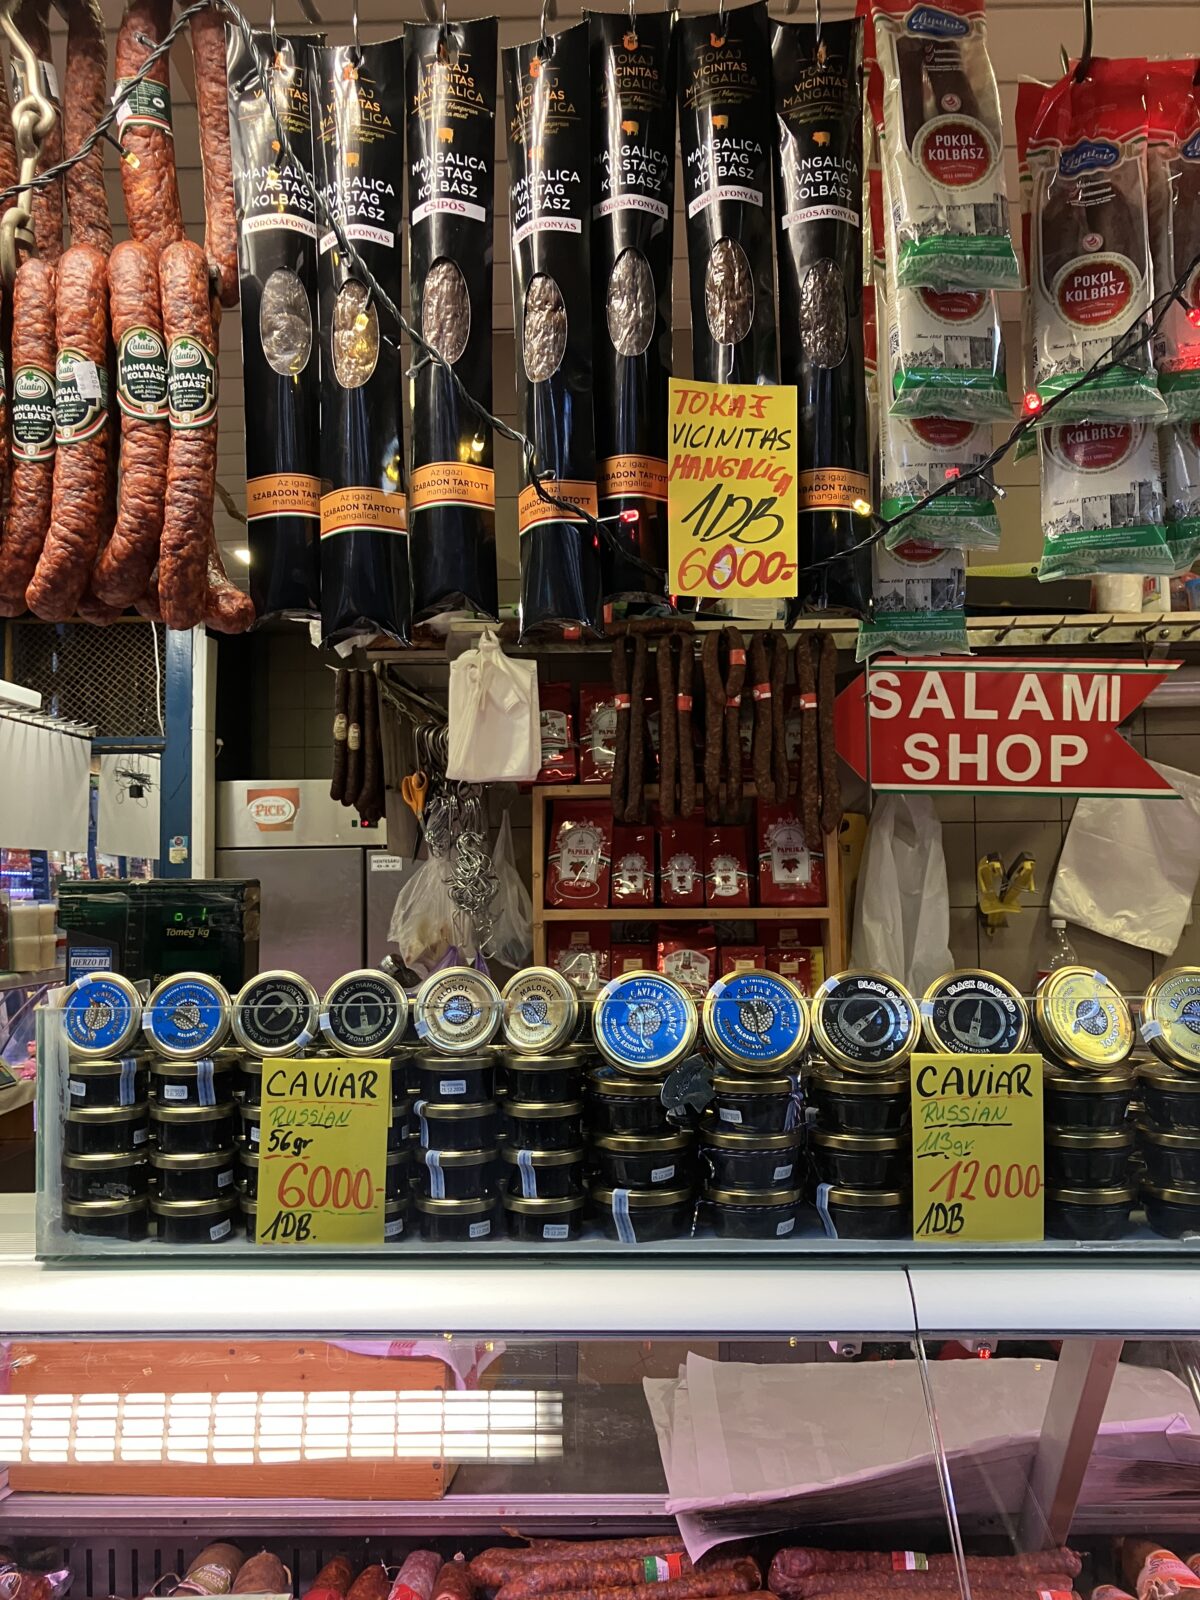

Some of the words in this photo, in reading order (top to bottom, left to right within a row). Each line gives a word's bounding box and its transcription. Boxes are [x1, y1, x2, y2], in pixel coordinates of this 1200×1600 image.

[693, 61, 748, 79] VICINITAS
[794, 76, 849, 92] VICINITAS
[936, 134, 976, 147] POKOL
[687, 137, 763, 167] MANGALICA
[928, 145, 985, 161] KOLBÁSZ
[412, 152, 488, 177] MANGALICA
[605, 159, 657, 175] VASTAG
[697, 152, 749, 170] VASTAG
[421, 166, 473, 183] VASTAG
[601, 173, 661, 192] KOLBÁSZ
[795, 170, 849, 186] VASTAG
[255, 179, 310, 197] VASTAG
[319, 176, 395, 197] MANGALICA
[418, 178, 479, 201] KOLBÁSZ
[792, 184, 853, 201] KOLBÁSZ
[251, 193, 315, 214] KOLBÁSZ
[517, 185, 565, 206] VASTAG
[514, 198, 571, 225] KOLBÁSZ
[1074, 270, 1117, 288] POKOL
[1065, 280, 1125, 303] KOLBÁSZ
[672, 422, 793, 451] VICINITAS
[431, 469, 440, 477] Az
[442, 468, 463, 478] igazi
[616, 461, 627, 469] Az
[629, 460, 650, 470] igazi
[277, 478, 288, 487] Az
[290, 478, 312, 489] igazi
[815, 473, 826, 481] Az
[828, 472, 848, 482] igazi
[413, 478, 450, 495] SZABADON
[452, 478, 489, 492] TARTOTT
[838, 484, 867, 496] TARTOTT
[252, 489, 299, 502] SZABADON
[340, 494, 350, 502] Az
[352, 492, 373, 503] igazi
[323, 502, 360, 520] SZABADON
[363, 502, 402, 516] TARTOTT
[868, 670, 1122, 723] SALAMI
[901, 732, 1089, 783] SHOP
[255, 803, 287, 817] PICK
[567, 848, 594, 856] PAPRIKA
[777, 846, 805, 854] PAPRIKA
[166, 928, 196, 938] Tömeg
[197, 927, 210, 938] kg
[72, 958, 98, 968] HERZO
[276, 983, 297, 998] RUSSIA
[337, 984, 356, 1003] BLACK
[355, 982, 386, 995] DIAMOND
[519, 984, 555, 1002] MALOSOL
[630, 987, 664, 1000] CAVIAR
[946, 980, 976, 996] BLACK
[976, 980, 1016, 1013] DIAMOND
[857, 980, 889, 995] BLACK
[885, 990, 909, 1033] DIAMOND
[345, 1033, 364, 1042] FROM
[365, 1026, 387, 1042] RUSSIA
[1101, 1003, 1119, 1049] MALOSOL
[916, 1201, 965, 1235] 1DB
